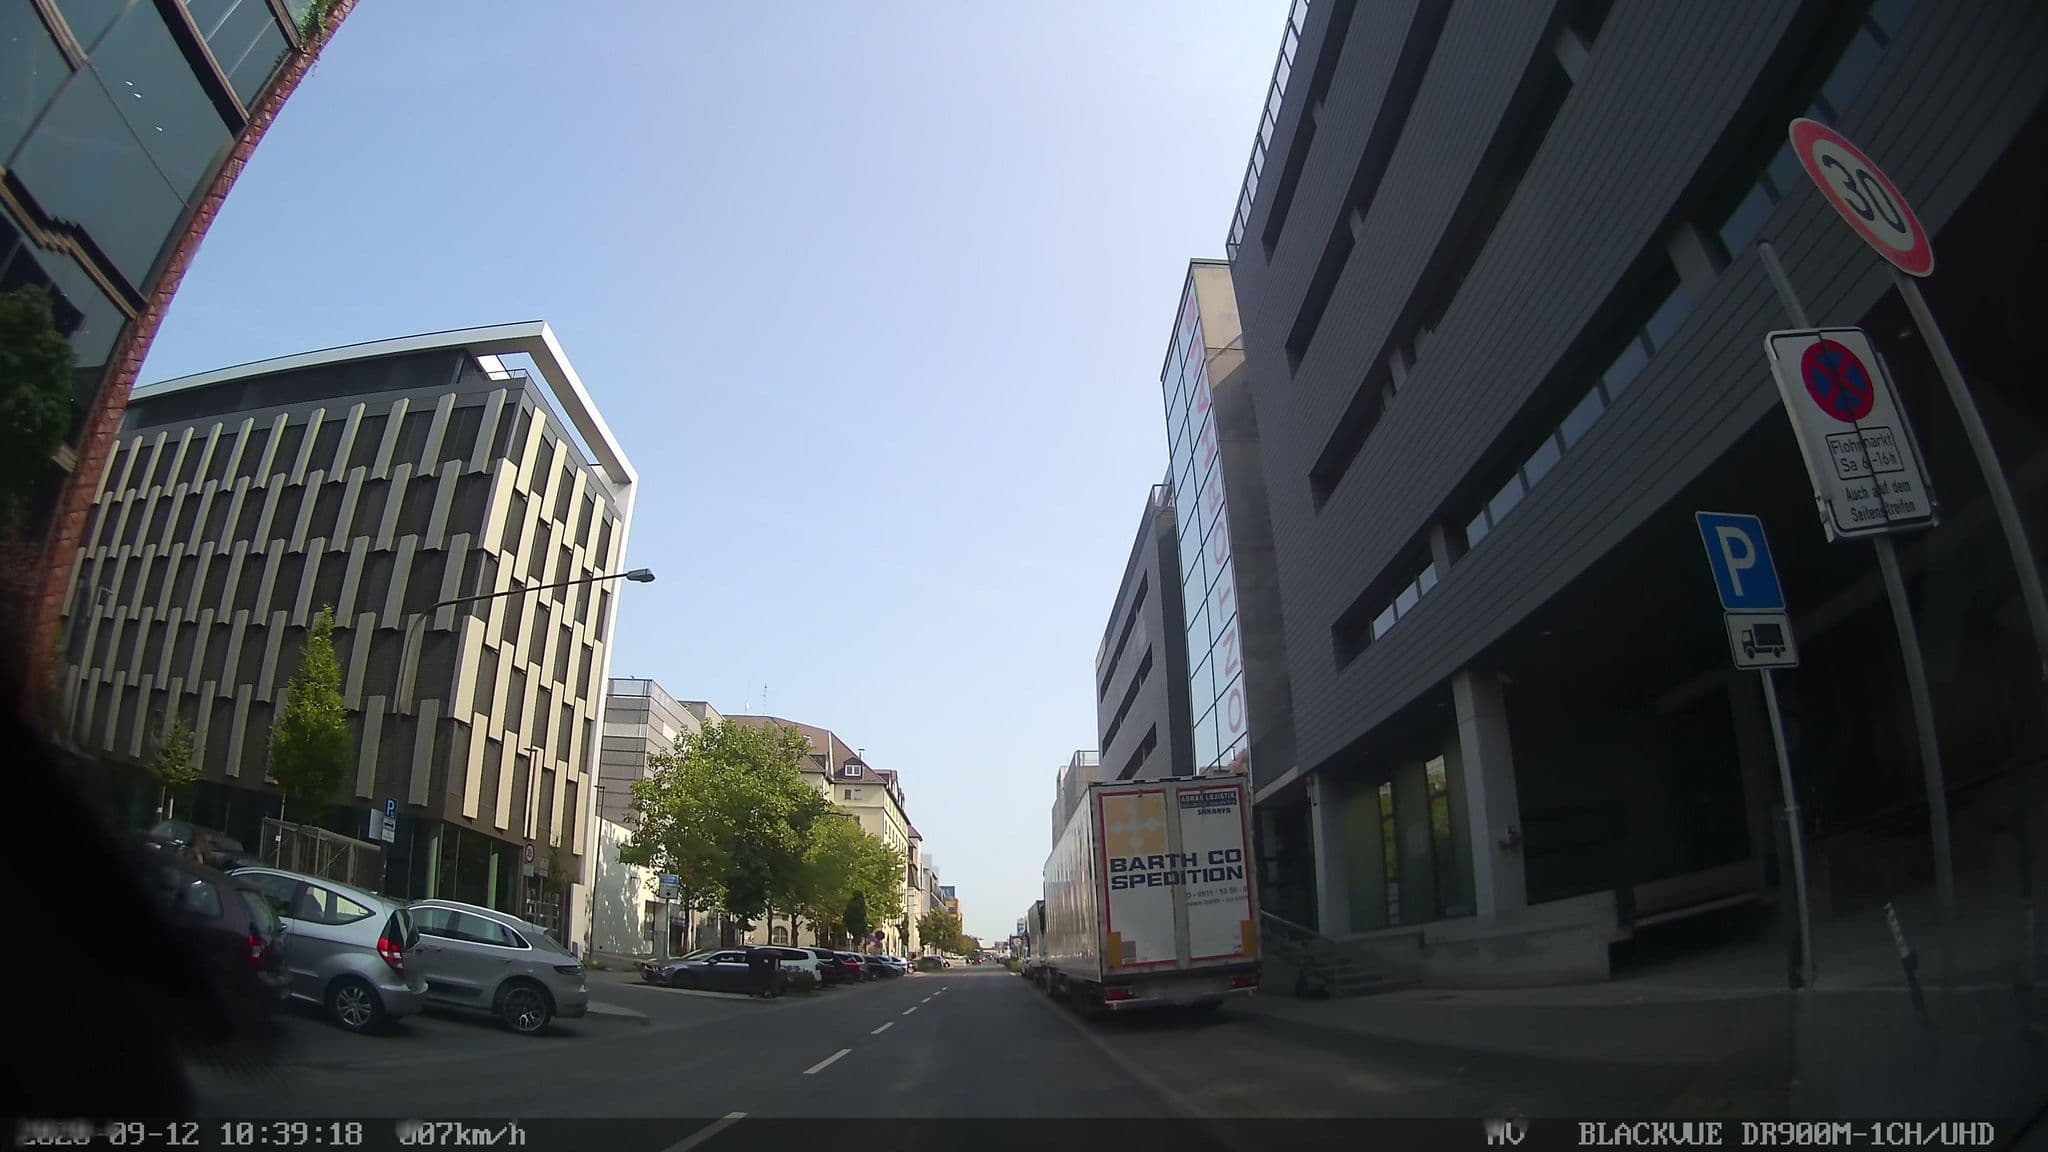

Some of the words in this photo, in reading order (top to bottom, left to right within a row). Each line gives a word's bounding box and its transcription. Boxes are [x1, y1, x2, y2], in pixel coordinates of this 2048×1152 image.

[1821, 153, 1906, 234] 30
[1840, 457, 1858, 472] Sa
[1845, 484, 1869, 502] Auch
[1892, 478, 1912, 493] dem
[1182, 294, 1244, 735] ONTORHAUS
[1714, 525, 1756, 598] P
[386, 799, 395, 816] P
[1110, 852, 1198, 873] BARTH
[1207, 848, 1242, 865] CO
[1111, 865, 1243, 890] SPEDITION
